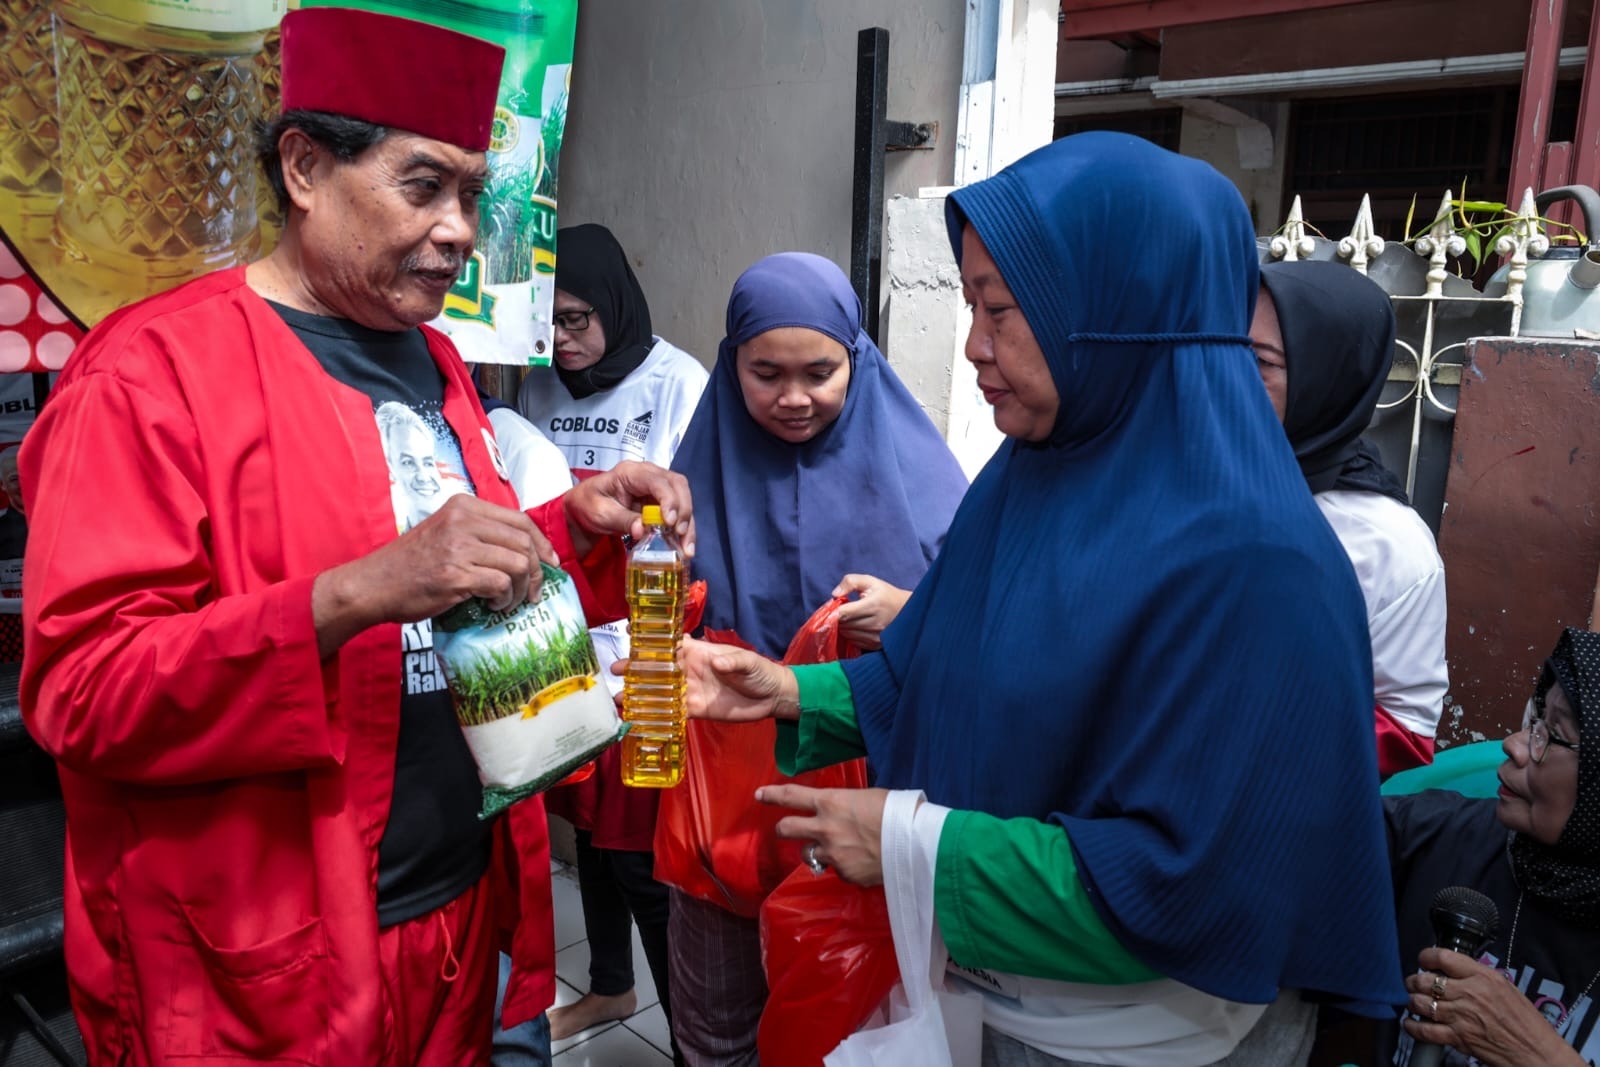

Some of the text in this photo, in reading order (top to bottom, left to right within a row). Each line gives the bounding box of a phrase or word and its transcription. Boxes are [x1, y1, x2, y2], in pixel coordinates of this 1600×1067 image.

[550, 417, 620, 435] COBLOS
[624, 428, 647, 441] MAHFUD
[626, 422, 650, 435] GANJAR
[584, 449, 595, 466] 3
[505, 607, 551, 635] Putih
